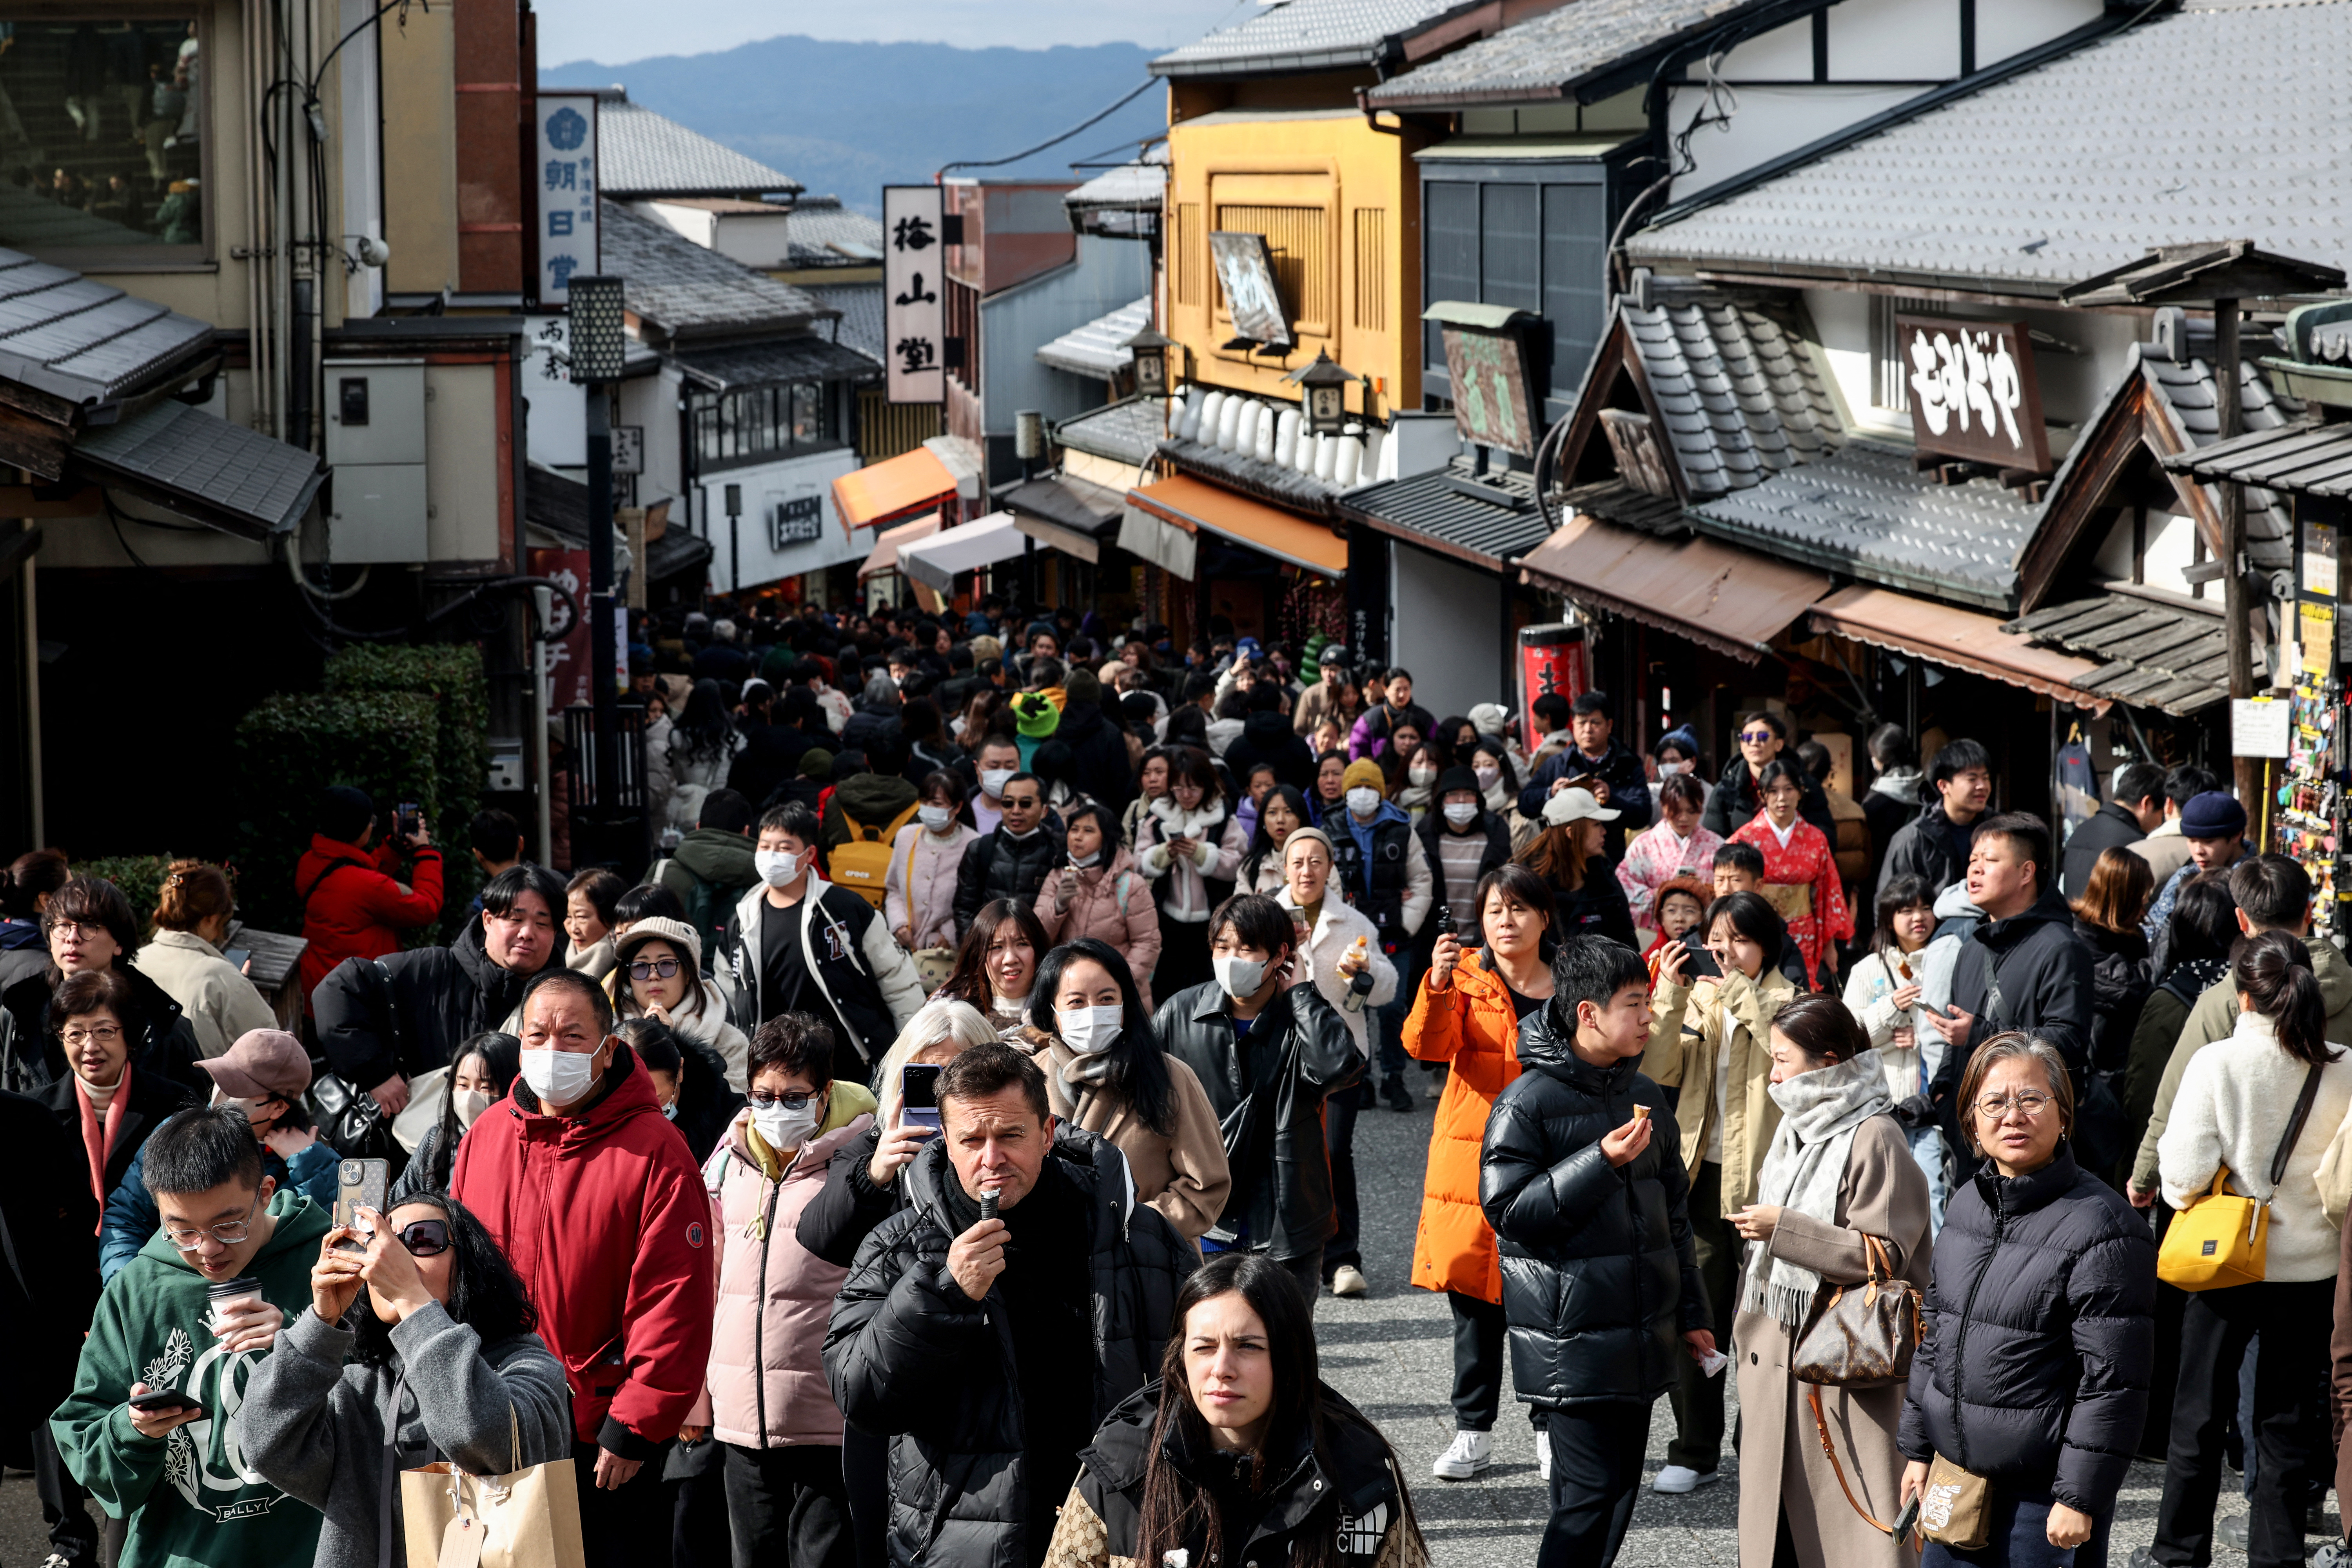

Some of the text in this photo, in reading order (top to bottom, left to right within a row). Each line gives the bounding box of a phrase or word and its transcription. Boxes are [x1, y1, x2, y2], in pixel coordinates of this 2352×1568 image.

[545, 158, 578, 289] 朝日堂
[893, 215, 940, 374] 梅山堂
[845, 870, 870, 879] crocs
[223, 1503, 262, 1519] BALLY
